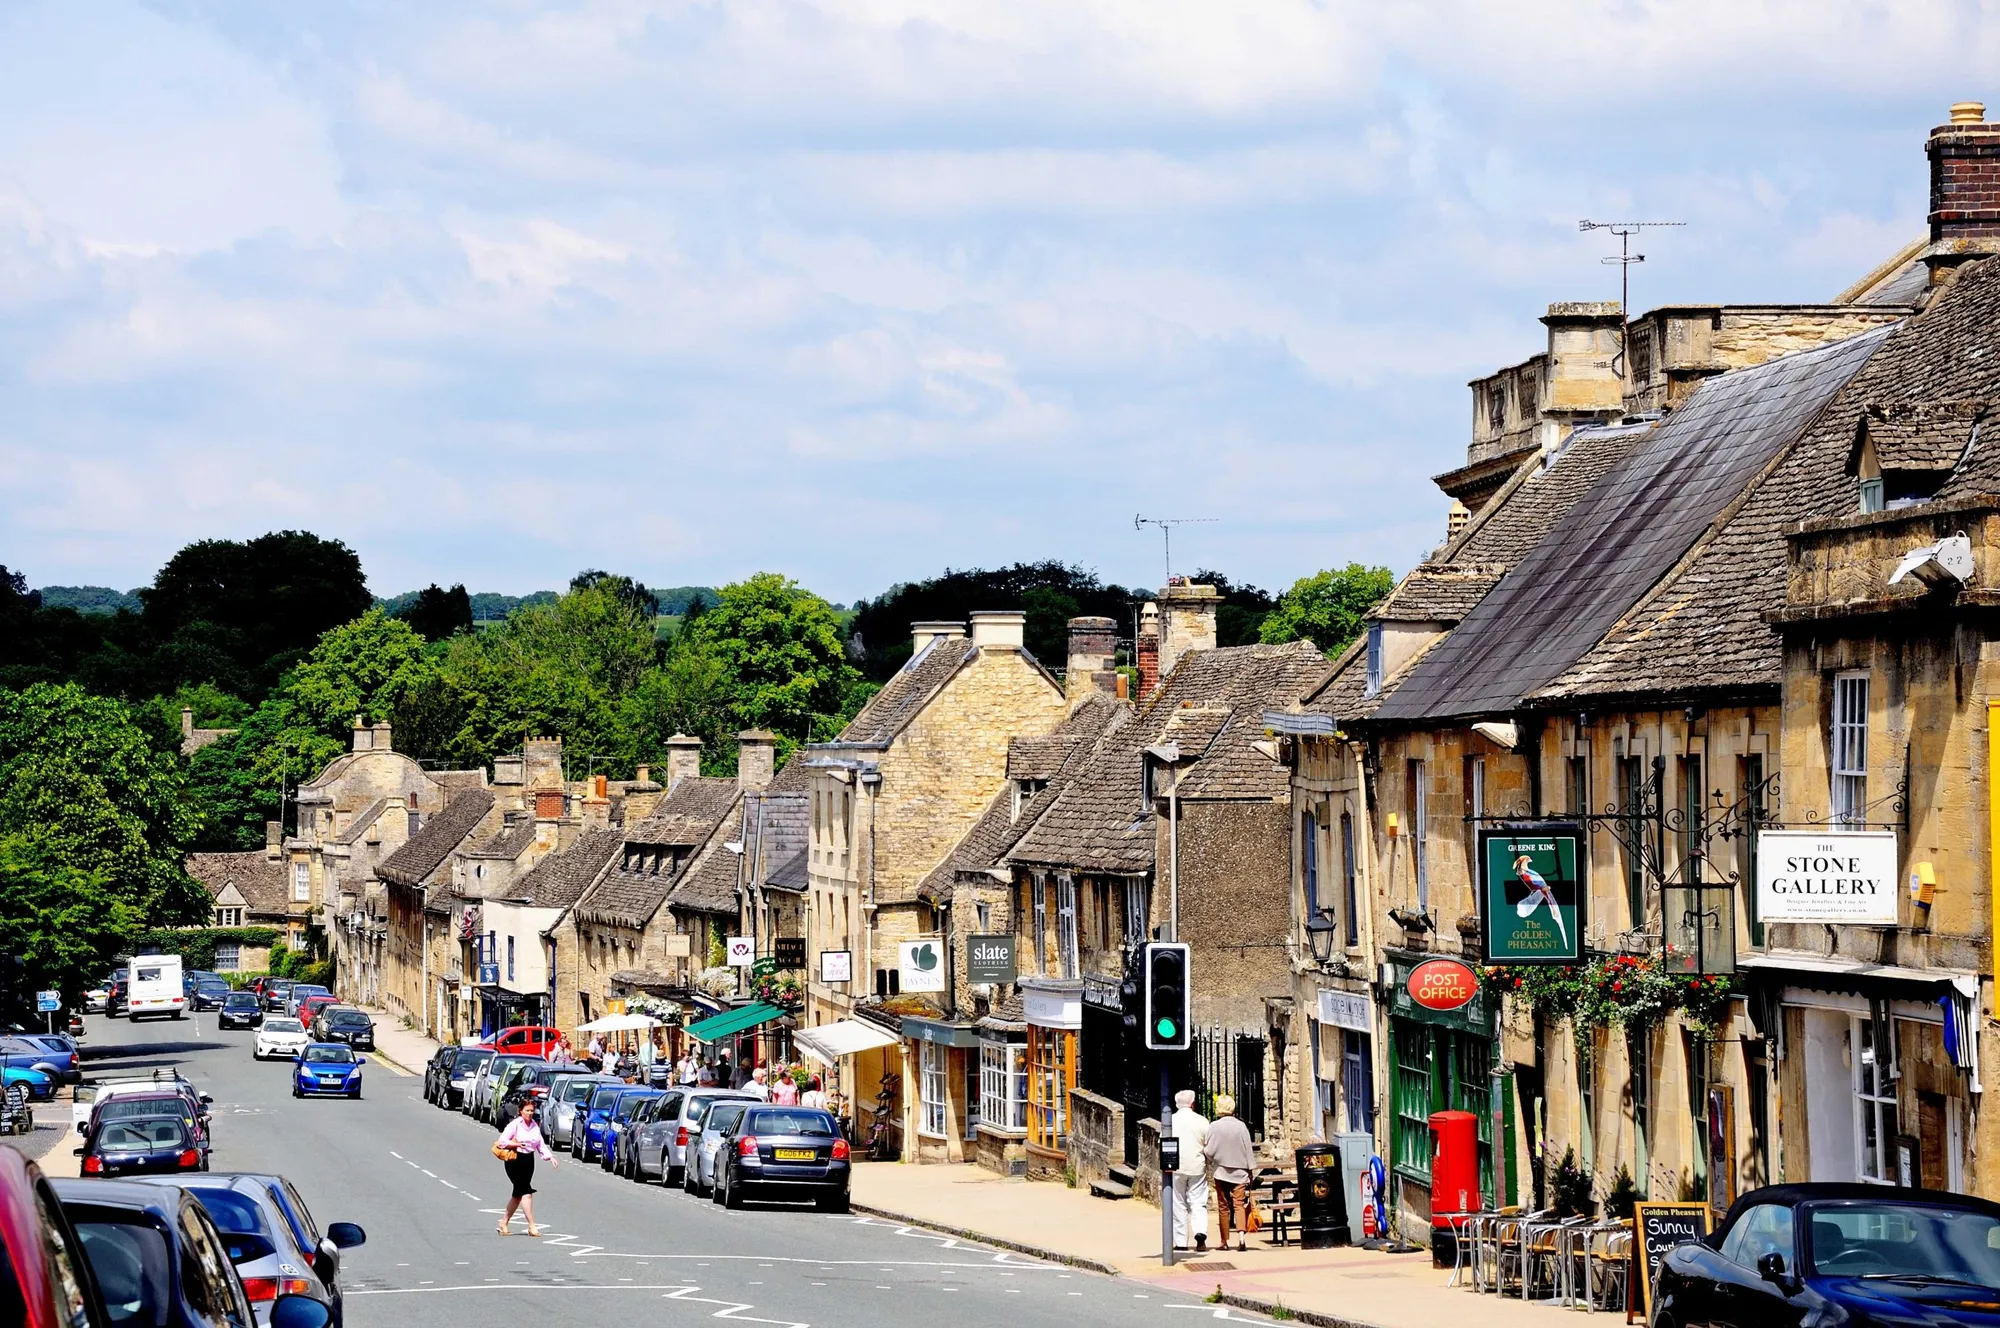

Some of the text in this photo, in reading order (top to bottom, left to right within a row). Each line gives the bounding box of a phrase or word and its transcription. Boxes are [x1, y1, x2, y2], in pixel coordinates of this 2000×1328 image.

[1507, 843, 1556, 852] GREENE KING
[1816, 844, 1836, 852] THE
[1786, 856, 1861, 873] STONE
[1772, 877, 1881, 895] GALLERY
[1524, 920, 1540, 929] The
[1512, 930, 1552, 940] GOLDEN
[1507, 940, 1559, 950] PHEASANT
[973, 943, 1009, 960] slate
[1424, 973, 1460, 986] POST
[1419, 986, 1467, 999] OFFICE
[778, 1149, 797, 1158] FG06
[798, 1150, 812, 1158] FKZ
[1642, 1208, 1704, 1217] Golden Pheasant
[1647, 1218, 1697, 1240] Sunny
